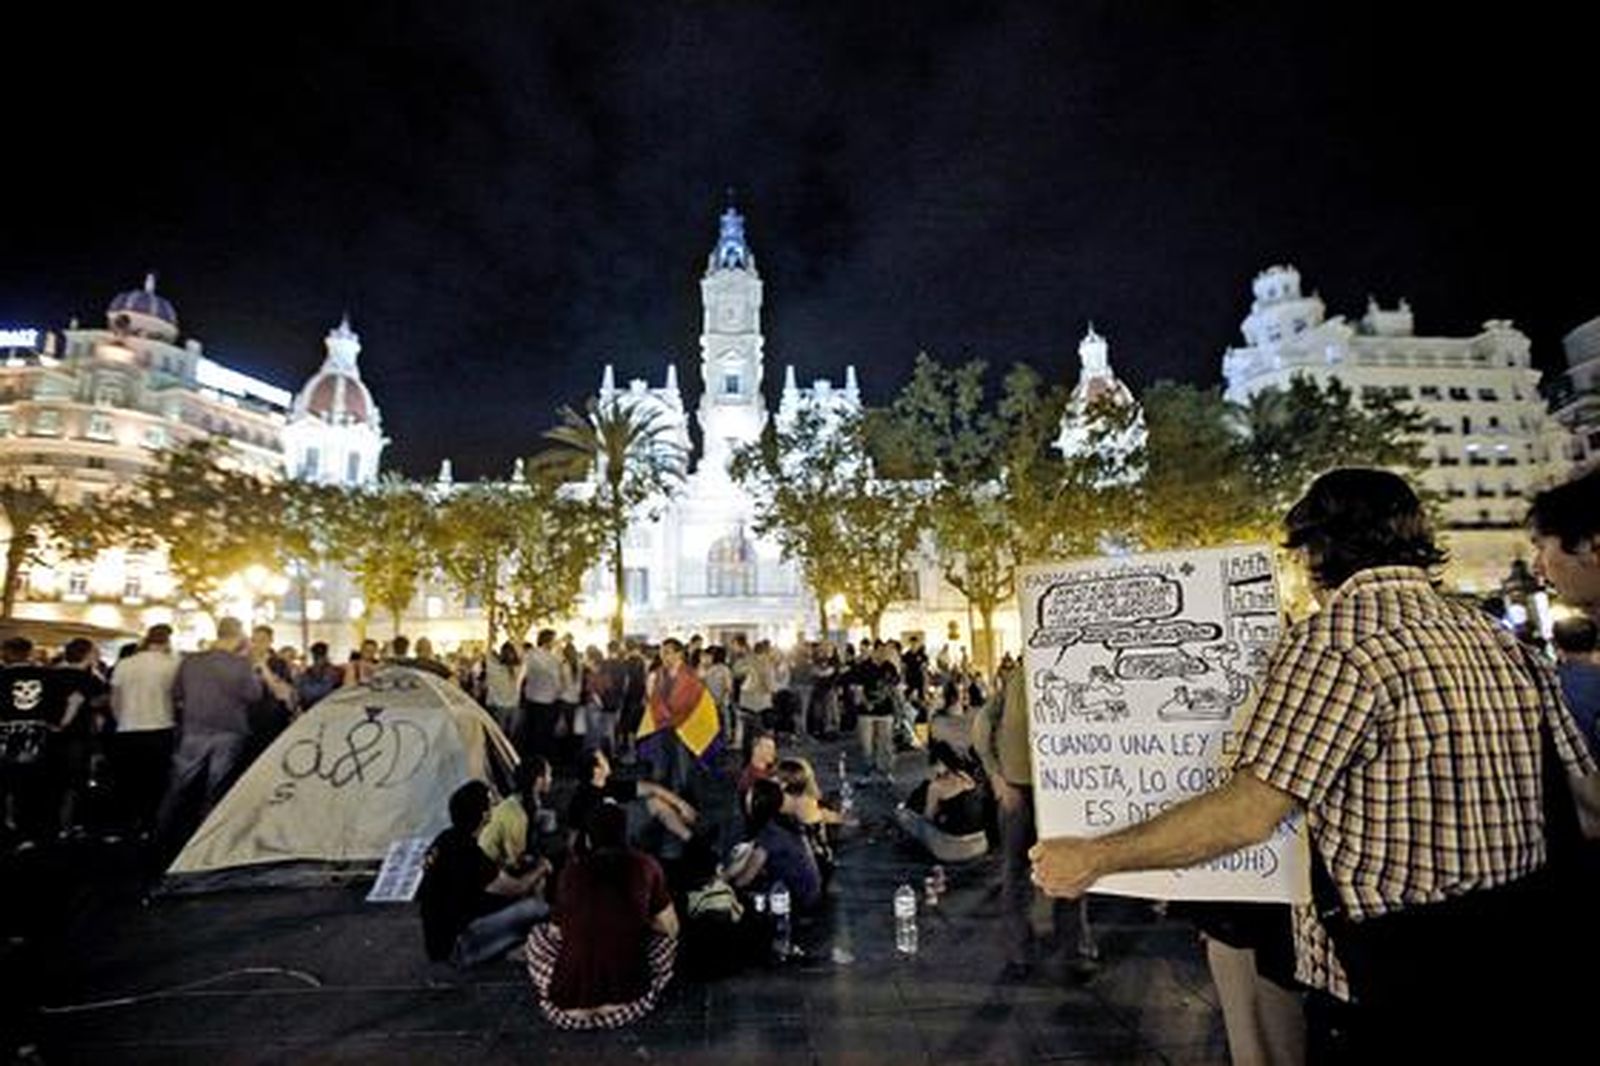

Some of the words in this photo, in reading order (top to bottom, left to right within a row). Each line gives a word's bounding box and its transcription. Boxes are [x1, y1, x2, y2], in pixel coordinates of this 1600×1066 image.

[1120, 733, 1166, 756] UNA
[1171, 732, 1209, 757] LEY
[1139, 767, 1167, 794] LO
[1084, 800, 1115, 827] ES
